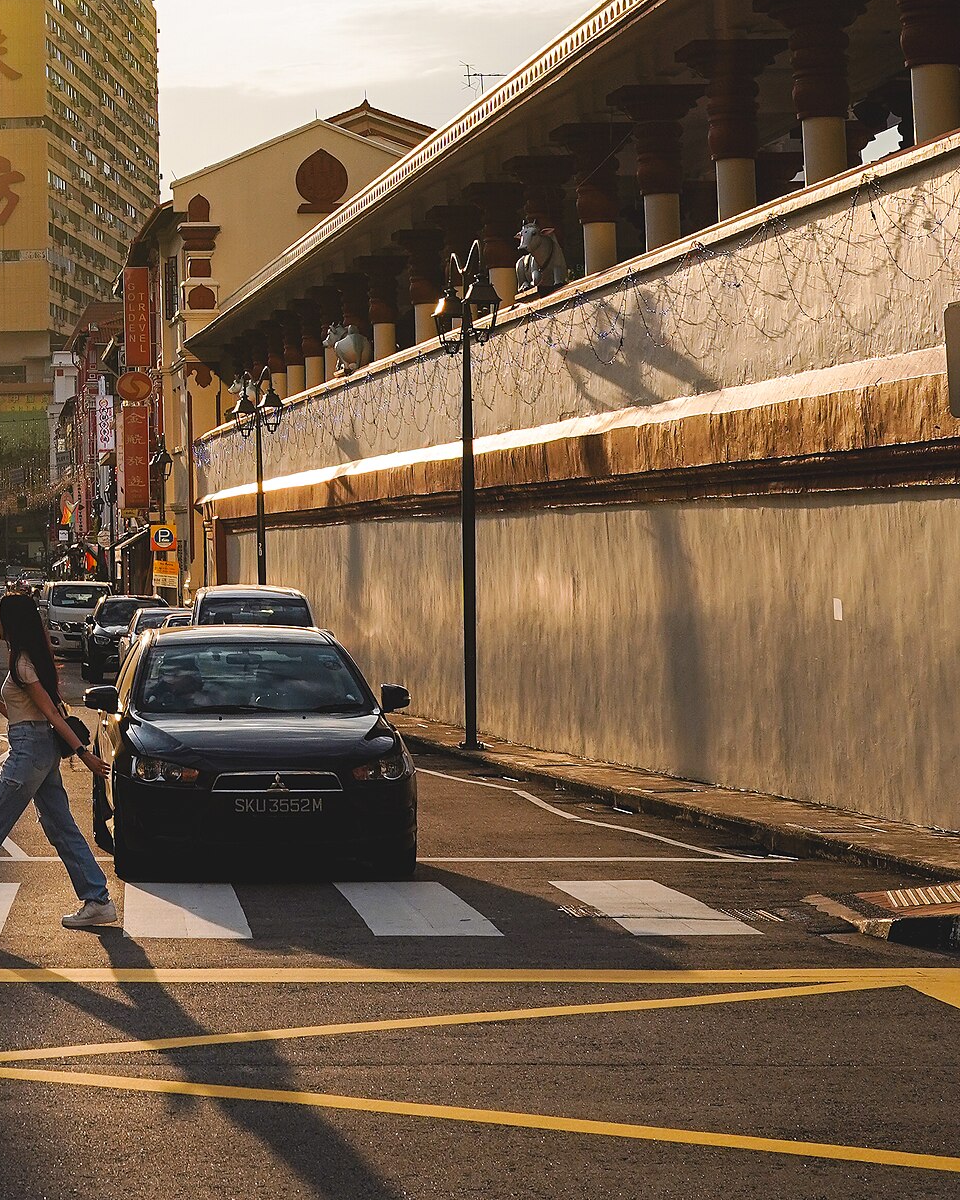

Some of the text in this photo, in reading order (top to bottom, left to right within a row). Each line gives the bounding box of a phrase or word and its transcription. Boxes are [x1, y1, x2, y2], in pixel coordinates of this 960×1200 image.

[127, 282, 136, 343] GOLDEN
[138, 292, 147, 353] TRAVEL
[234, 798, 323, 813] SKU3552M
